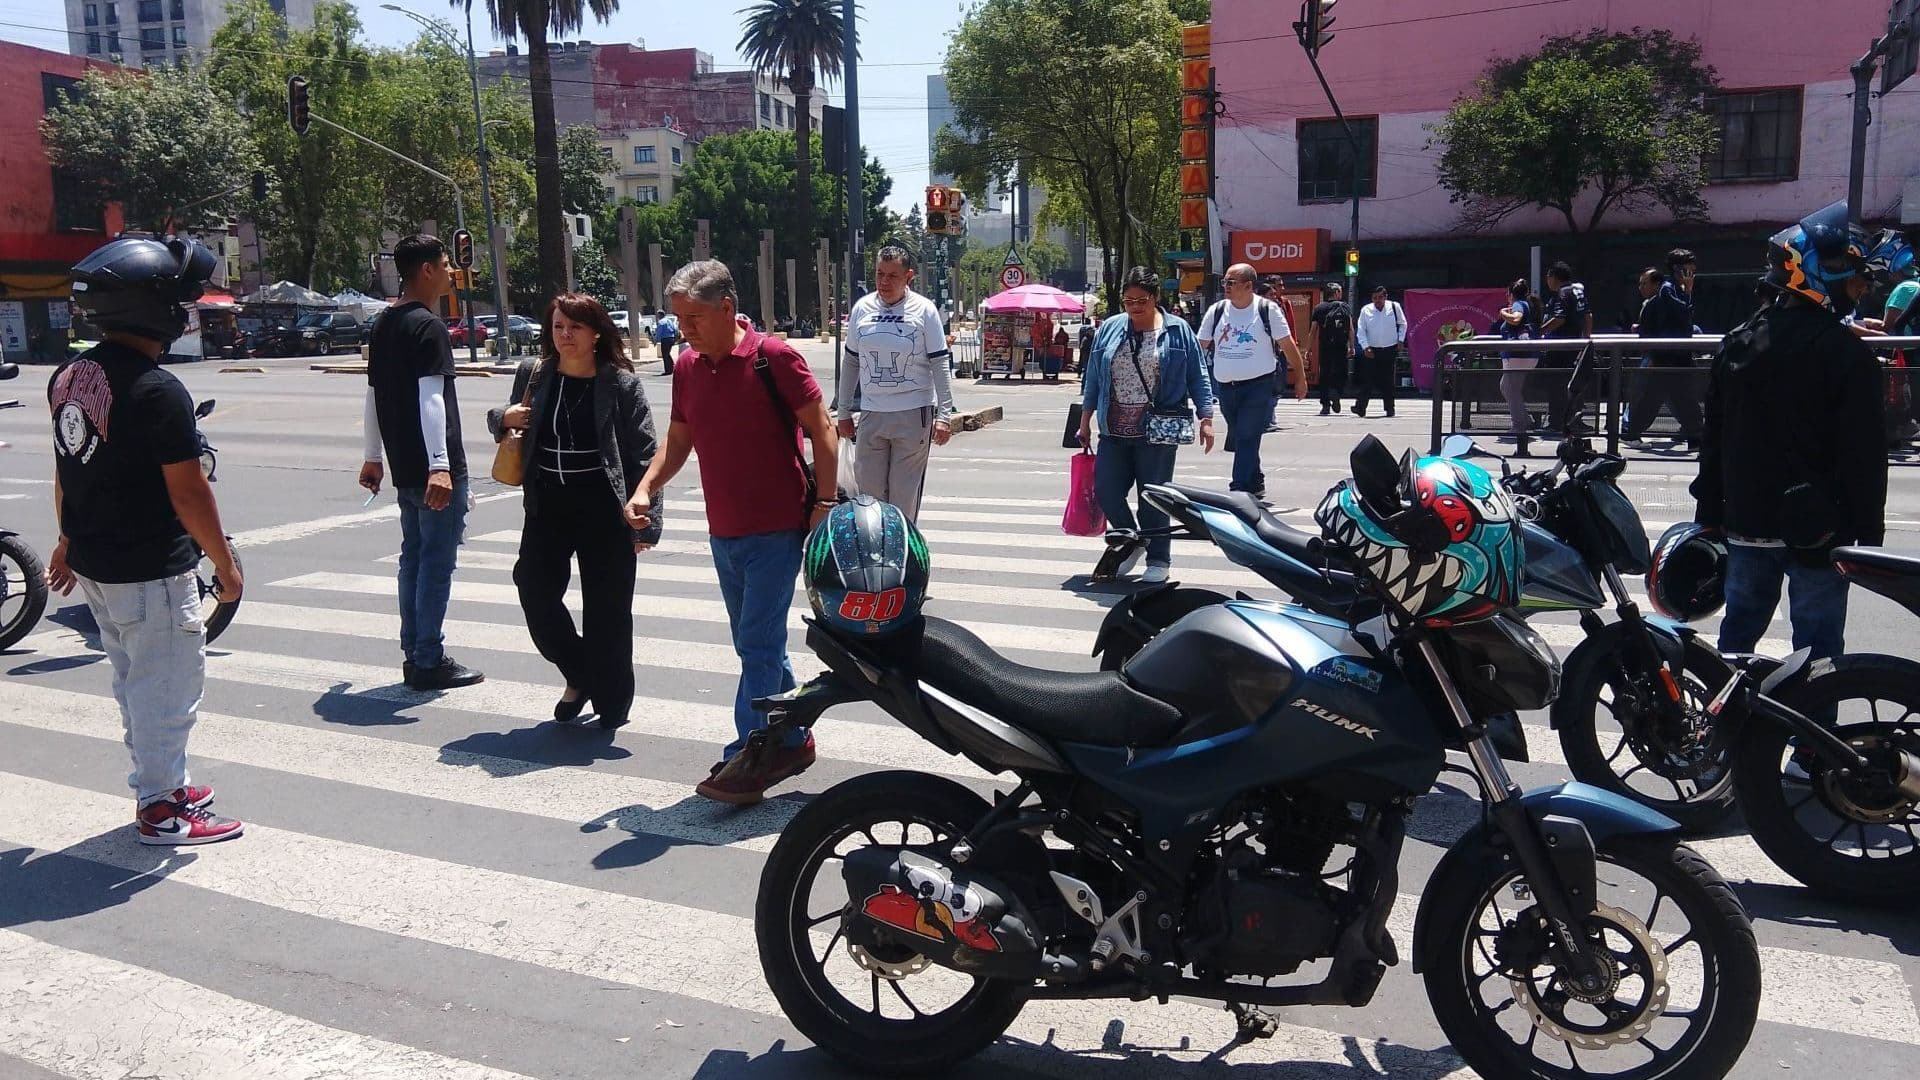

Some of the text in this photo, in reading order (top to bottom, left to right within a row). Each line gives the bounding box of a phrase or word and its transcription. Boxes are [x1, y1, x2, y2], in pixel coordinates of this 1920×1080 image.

[1184, 62, 1208, 227] KODAK
[1269, 244, 1303, 259] DiDi
[1007, 270, 1019, 280] 30
[870, 315, 905, 323] DHL
[839, 588, 906, 621] 80
[1290, 698, 1382, 741] HUNK
[1553, 917, 1580, 954] ABS
